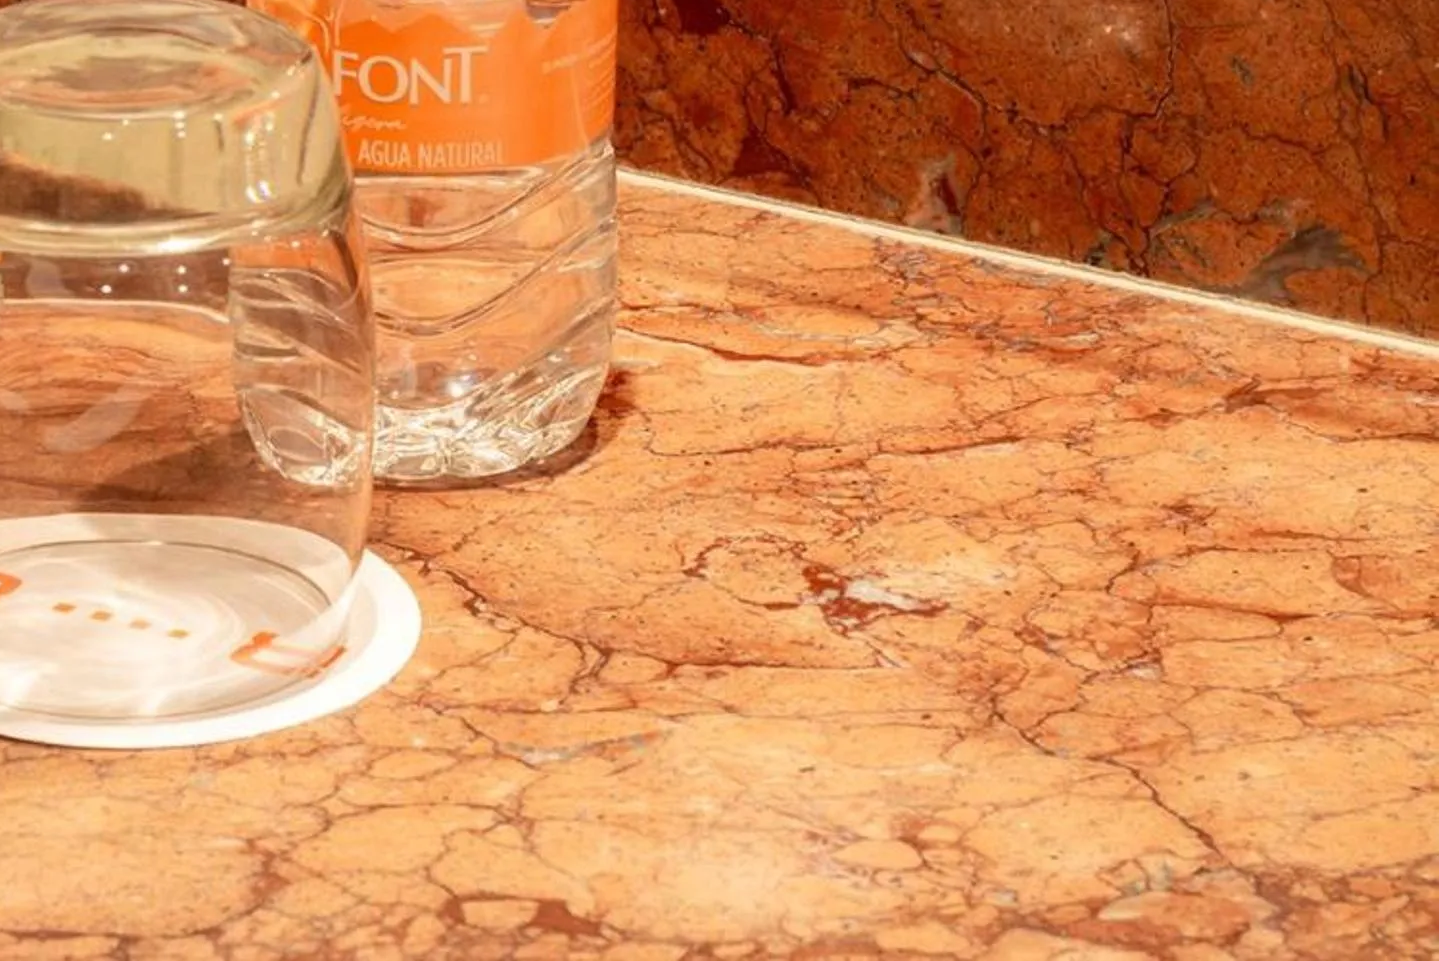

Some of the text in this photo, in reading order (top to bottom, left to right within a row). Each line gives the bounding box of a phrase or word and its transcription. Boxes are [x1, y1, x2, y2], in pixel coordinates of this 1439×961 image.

[332, 46, 488, 105] FONT
[358, 139, 504, 169] AGUA NATURAL
